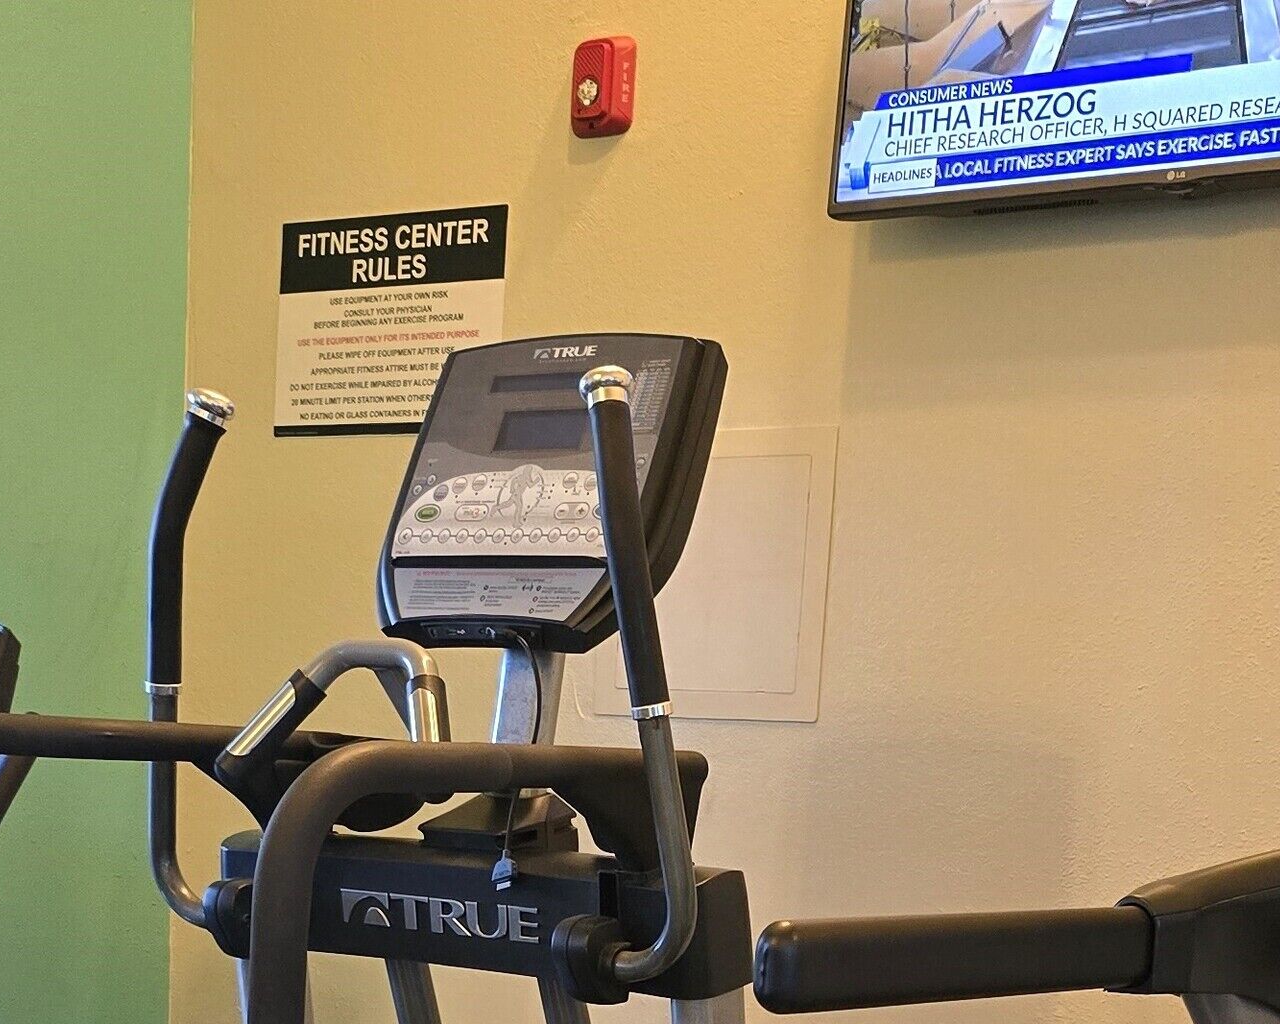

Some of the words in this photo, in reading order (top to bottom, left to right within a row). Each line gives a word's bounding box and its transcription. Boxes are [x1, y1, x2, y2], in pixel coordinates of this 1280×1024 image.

[621, 61, 630, 103] FIRE
[888, 85, 967, 107] CONSUMER
[970, 79, 1013, 97] NEWS
[887, 104, 972, 138] HITHA
[978, 88, 1097, 128] HERZOG
[884, 137, 933, 157] CHIEF
[937, 127, 1024, 152] RESEARCH
[1030, 117, 1107, 140] OFFICER,
[1113, 114, 1127, 132] H
[1132, 103, 1223, 131] SQUARED
[944, 158, 992, 179] LOCAL
[993, 151, 1054, 174] FITNESS
[1055, 144, 1115, 166] EXPERT
[1115, 141, 1155, 160] SAYS
[1156, 131, 1236, 156] EXERCISE,
[872, 167, 932, 184] HEADLINES
[298, 227, 389, 257] FITNESS
[395, 218, 489, 250] CENTER
[352, 254, 427, 283] RULES
[329, 297, 343, 306] USE
[344, 294, 382, 305] EQUIPMENT
[383, 293, 393, 302] AT
[393, 292, 412, 302] YOUR
[414, 291, 431, 300] OWN
[432, 290, 448, 299] RISK
[344, 308, 374, 318] CONSULT
[376, 307, 395, 316] YOUR
[396, 305, 432, 315] PHYSICIAN
[314, 320, 340, 329] BEFORE
[341, 317, 377, 328] BEGINNING
[378, 317, 394, 326] ANY
[394, 314, 427, 325] EXERCISE
[428, 313, 464, 322] PROGRAM
[297, 338, 312, 347] USE
[312, 337, 325, 346] THE
[326, 336, 363, 346] EQUIPMENT
[364, 334, 382, 343] ONLY
[383, 333, 397, 342] FOR
[411, 331, 445, 341] INTENDED
[446, 329, 480, 339] PURPOSE
[319, 351, 344, 360] PLEASE
[344, 350, 362, 359] WIPE
[362, 349, 375, 358] OFF
[377, 348, 416, 358] EQUIPMENT
[417, 347, 440, 356] AFTER
[551, 344, 598, 359] TRUE
[310, 366, 355, 376] APPROPRIATE
[356, 365, 384, 374] FITNESS
[385, 364, 408, 373] ATTIRE
[409, 363, 428, 372] MUST
[430, 363, 439, 371] BE
[290, 383, 300, 392] DO
[300, 383, 314, 391] NOT
[315, 381, 347, 391] EXERCISE
[348, 380, 369, 389] WHILE
[370, 379, 402, 388] IMPAIRED
[403, 379, 412, 387] BY
[299, 397, 323, 406] MINUTE
[324, 396, 341, 405] LIMIT
[342, 396, 356, 405] PER
[357, 395, 385, 404] STATION
[385, 395, 406, 404] WHEN
[299, 412, 309, 421] NO
[310, 412, 334, 421] EATING
[335, 411, 345, 419] OR
[346, 411, 368, 419] GLASS
[369, 409, 411, 418] CONTAINERS
[412, 409, 420, 417] IN
[388, 892, 540, 944] TRUE
